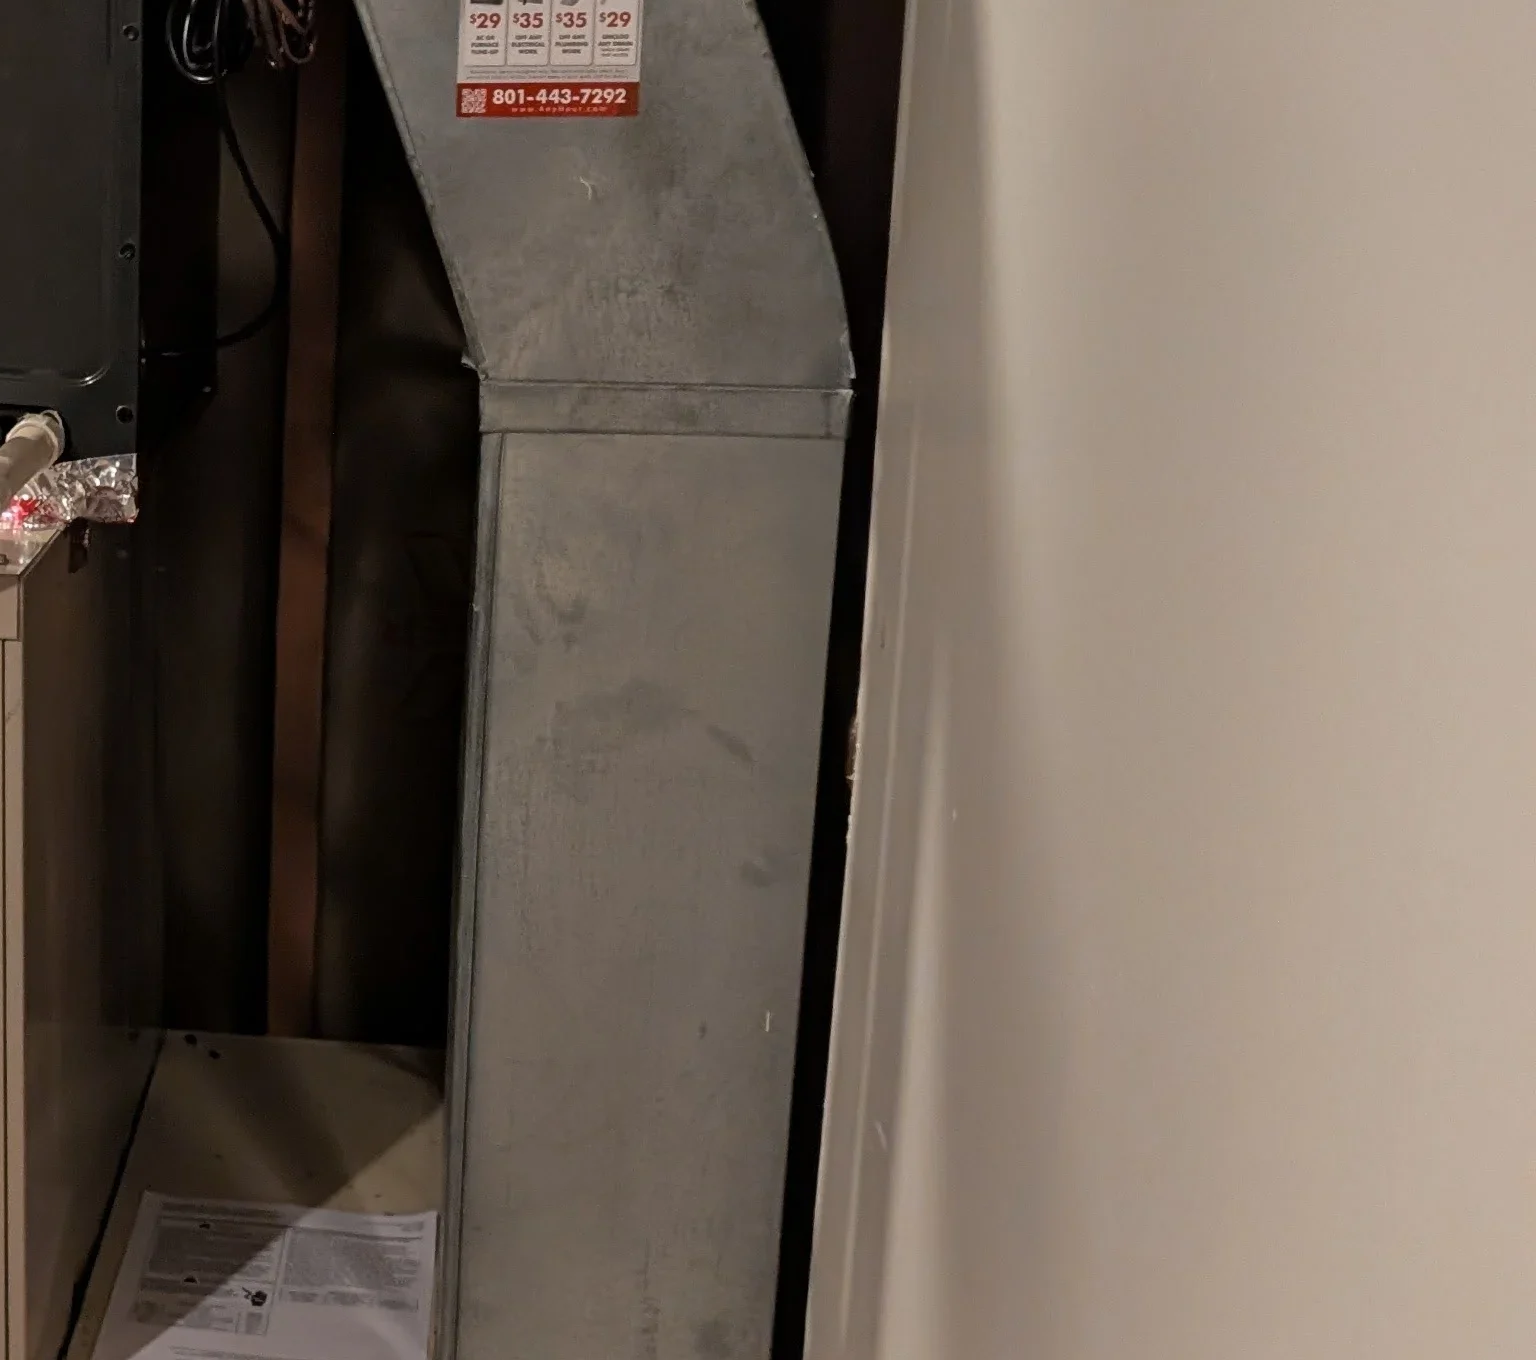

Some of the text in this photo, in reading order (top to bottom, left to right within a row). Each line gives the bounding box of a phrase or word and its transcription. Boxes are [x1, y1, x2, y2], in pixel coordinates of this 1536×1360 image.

[469, 12, 502, 30] $29
[512, 11, 544, 29] $35
[555, 11, 588, 29] $35
[599, 11, 632, 28] $29
[492, 88, 627, 105] 801-443-7292
